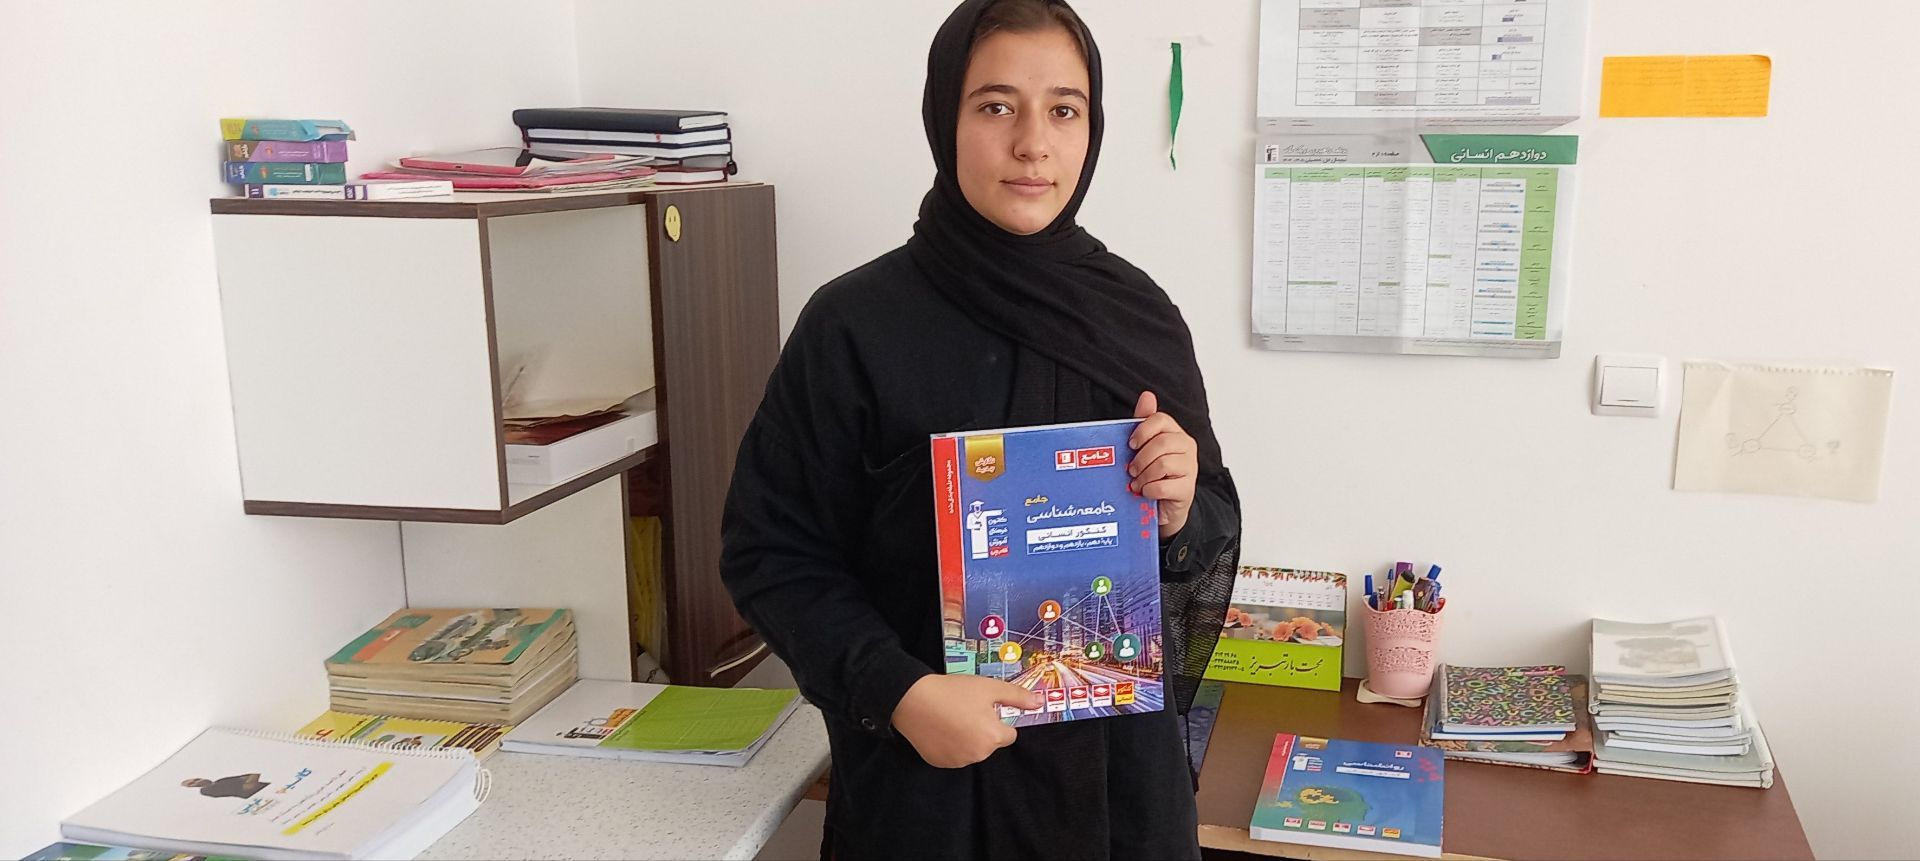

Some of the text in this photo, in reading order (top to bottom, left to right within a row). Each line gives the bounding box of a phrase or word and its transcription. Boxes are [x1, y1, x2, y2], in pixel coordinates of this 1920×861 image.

[1450, 148, 1547, 163] دوازدهم انسانی
[1080, 450, 1110, 464] جامع
[1024, 494, 1049, 507] جامع
[1038, 525, 1108, 542] کنکور انسانی
[1248, 653, 1288, 676] تبریز
